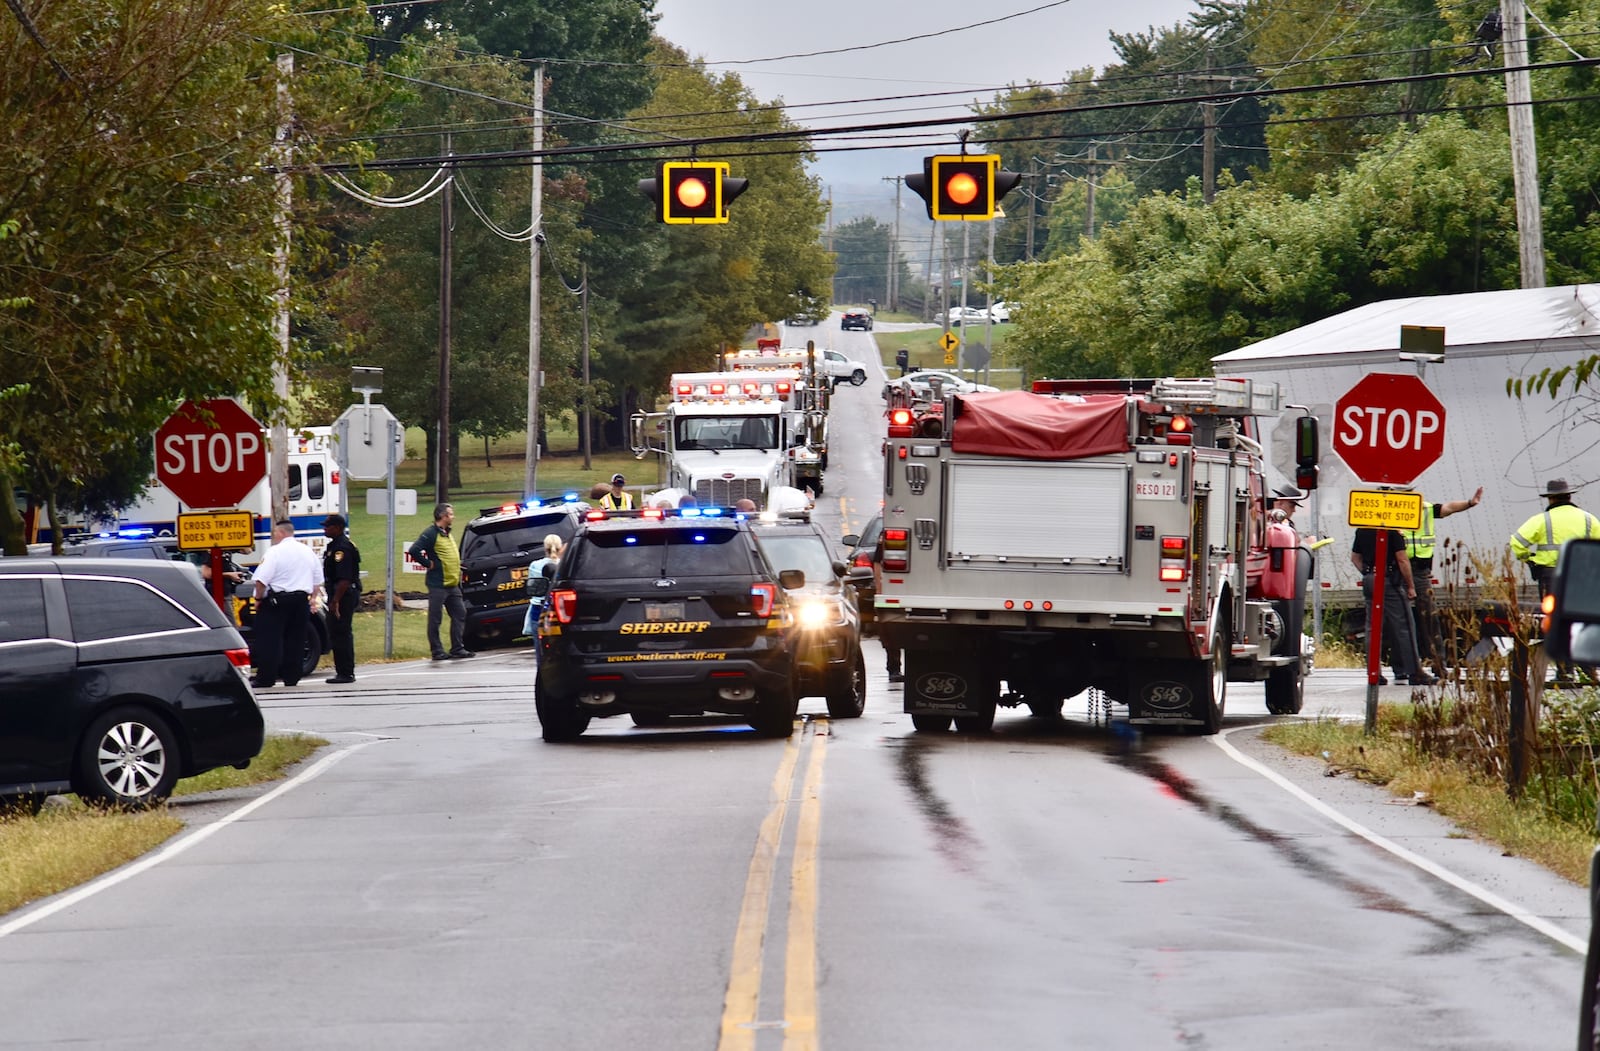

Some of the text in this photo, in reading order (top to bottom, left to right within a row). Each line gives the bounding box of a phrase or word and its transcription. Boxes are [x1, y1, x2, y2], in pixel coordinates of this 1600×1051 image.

[1340, 405, 1439, 451] STOP
[163, 431, 259, 475] STOP
[1162, 485, 1176, 496] 121
[1354, 498, 1416, 510] CROSS TRAFFIC
[1353, 510, 1416, 521] DOES NOT STOP
[183, 519, 247, 531] CROSS TRAFFIC
[183, 532, 206, 542] DOES
[209, 532, 225, 541] NOT
[227, 531, 248, 540] STOP
[496, 580, 526, 592] SHE
[619, 621, 712, 635] SHERIFF
[607, 651, 727, 663] www.butlersheriff.org
[925, 677, 958, 694] S&S
[1150, 686, 1183, 702] S&S
